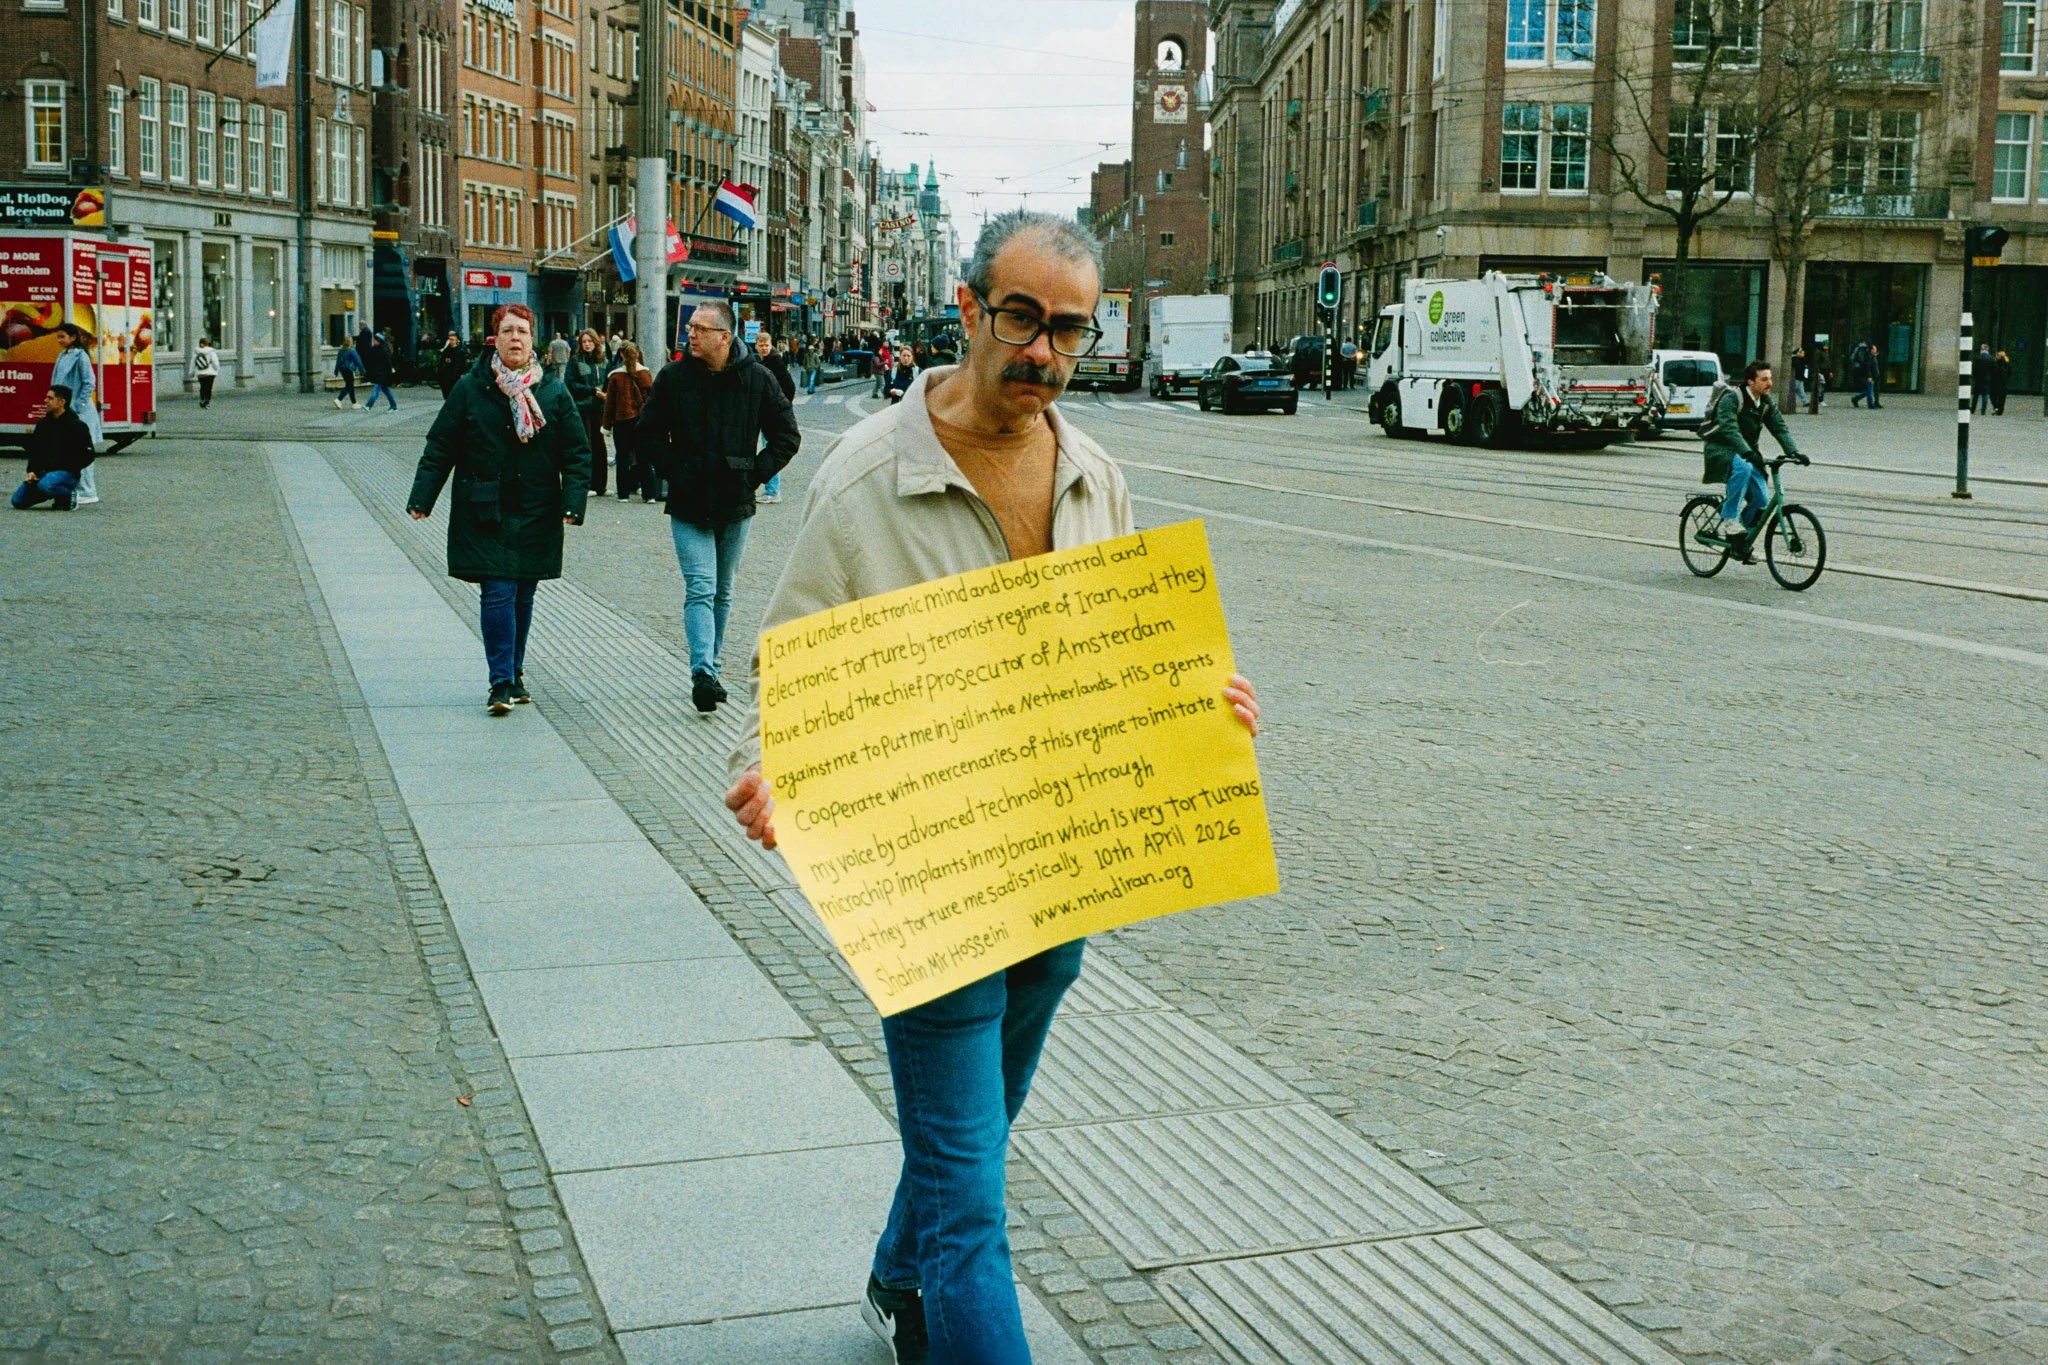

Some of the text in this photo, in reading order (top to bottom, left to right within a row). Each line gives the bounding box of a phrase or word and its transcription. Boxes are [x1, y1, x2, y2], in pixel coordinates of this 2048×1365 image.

[13, 252, 40, 260] MORE
[879, 218, 911, 229] CASINO
[1430, 328, 1466, 342] collective
[1444, 312, 1466, 327] green
[765, 534, 1149, 669] I am under electronic mind and body control and
[766, 672, 839, 708] electronic
[842, 644, 907, 679] torture
[907, 632, 928, 664] by
[928, 615, 998, 656] terrorist
[996, 600, 1052, 636] regime
[1055, 592, 1072, 617] of
[1128, 573, 1159, 599] and
[1160, 565, 1207, 593] they
[763, 613, 1176, 750] have bribed the chief prosecutor of Amsterdam
[775, 760, 832, 800] against
[833, 750, 859, 772] me
[860, 742, 881, 762] to
[909, 725, 934, 746] me
[934, 718, 951, 739] in
[949, 705, 975, 744] jail
[974, 709, 990, 725] in
[988, 700, 1017, 719] the
[1120, 663, 1150, 689] His
[1152, 653, 1215, 688] agents
[887, 772, 922, 802] with
[921, 745, 1019, 789] mercenaries
[1020, 735, 1038, 760] of
[1040, 727, 1075, 753] this
[1074, 720, 1128, 755] regime
[1128, 714, 1149, 732] to
[1147, 695, 1217, 727] imitate
[809, 755, 1156, 885] my voice by advanced technology through
[818, 877, 895, 921] microchip
[895, 858, 969, 897] implants
[967, 848, 985, 868] in
[983, 845, 1009, 869] my
[1004, 830, 1054, 861] brain
[1057, 811, 1110, 846] which
[1110, 808, 1129, 830] is
[1129, 801, 1165, 826] very
[842, 920, 871, 957] and
[870, 917, 906, 949] they
[903, 900, 963, 937] torture
[963, 889, 989, 912] me
[1094, 838, 1135, 871] 10th
[1195, 818, 1242, 845] 2026
[875, 955, 930, 997] Shahin
[1029, 864, 1195, 928] www.mindiran.org
